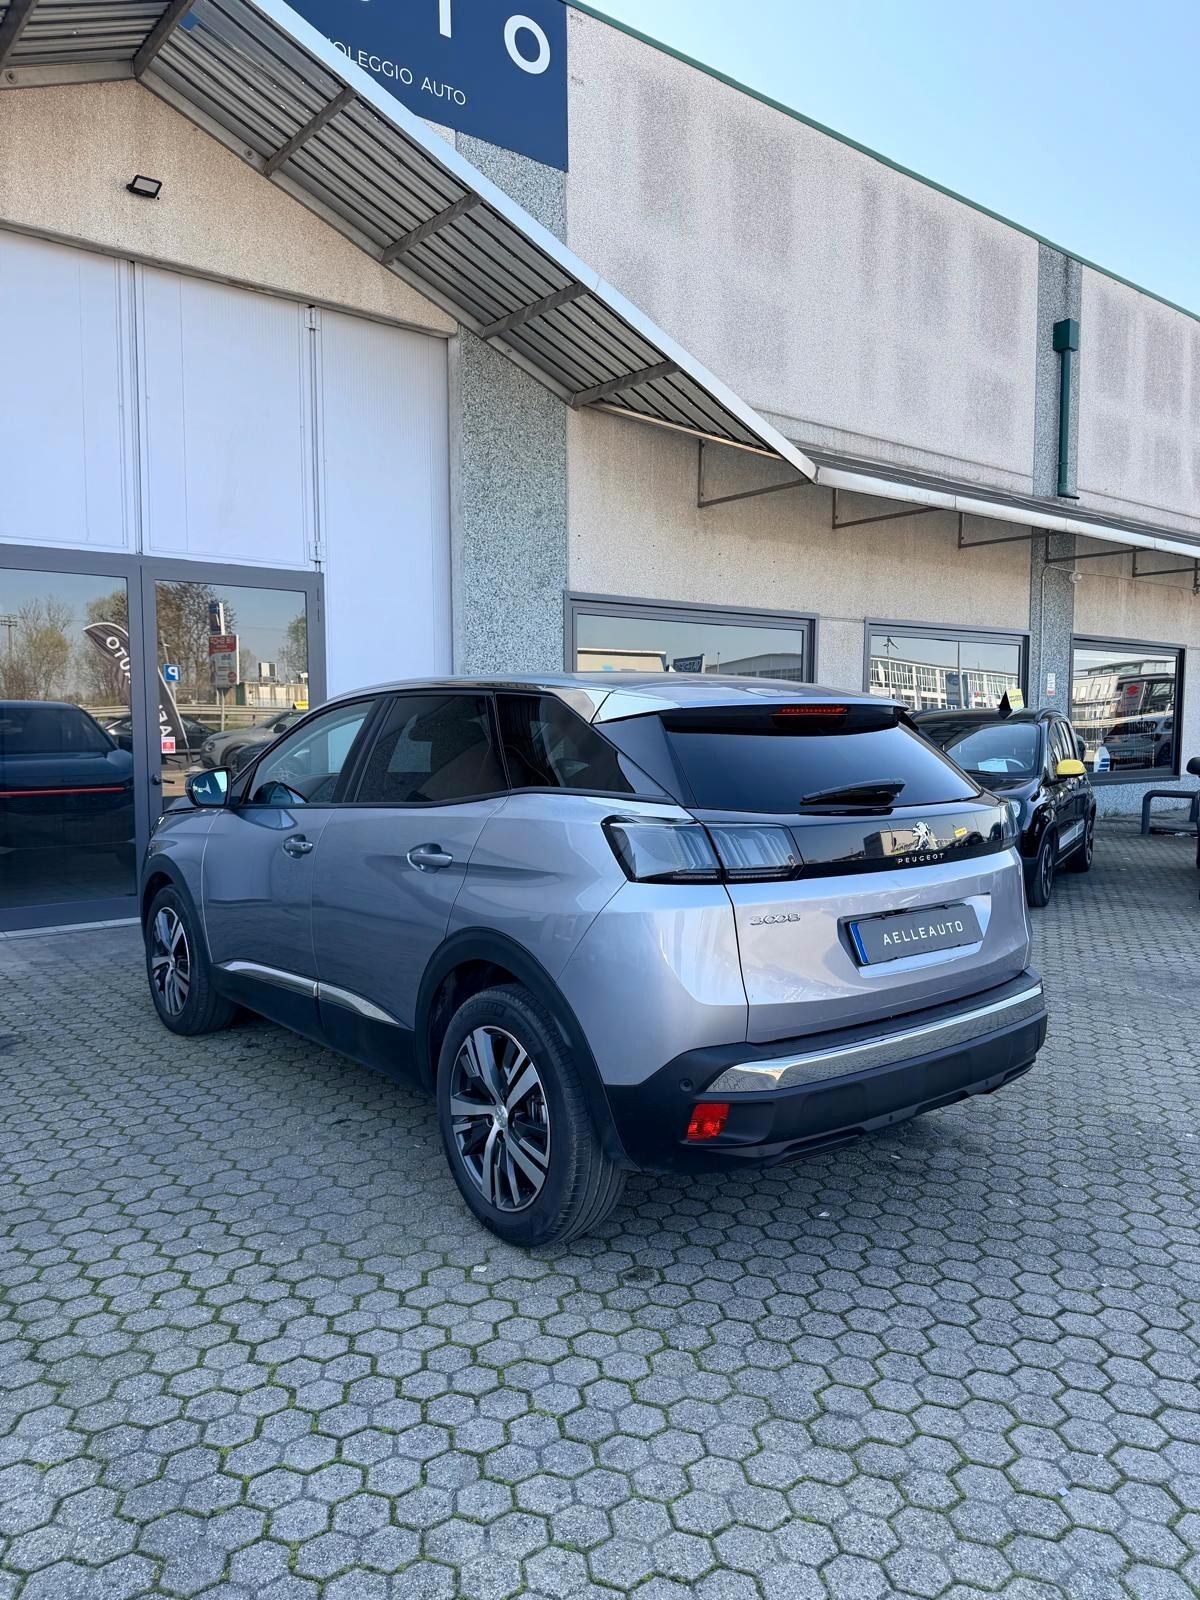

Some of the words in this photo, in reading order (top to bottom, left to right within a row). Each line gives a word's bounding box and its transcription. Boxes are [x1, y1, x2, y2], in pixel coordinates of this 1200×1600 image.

[421, 77, 466, 105] AUTO
[897, 852, 945, 864] PEUGEOT
[749, 913, 801, 926] 3008
[882, 920, 964, 946] AELLEAUTO
